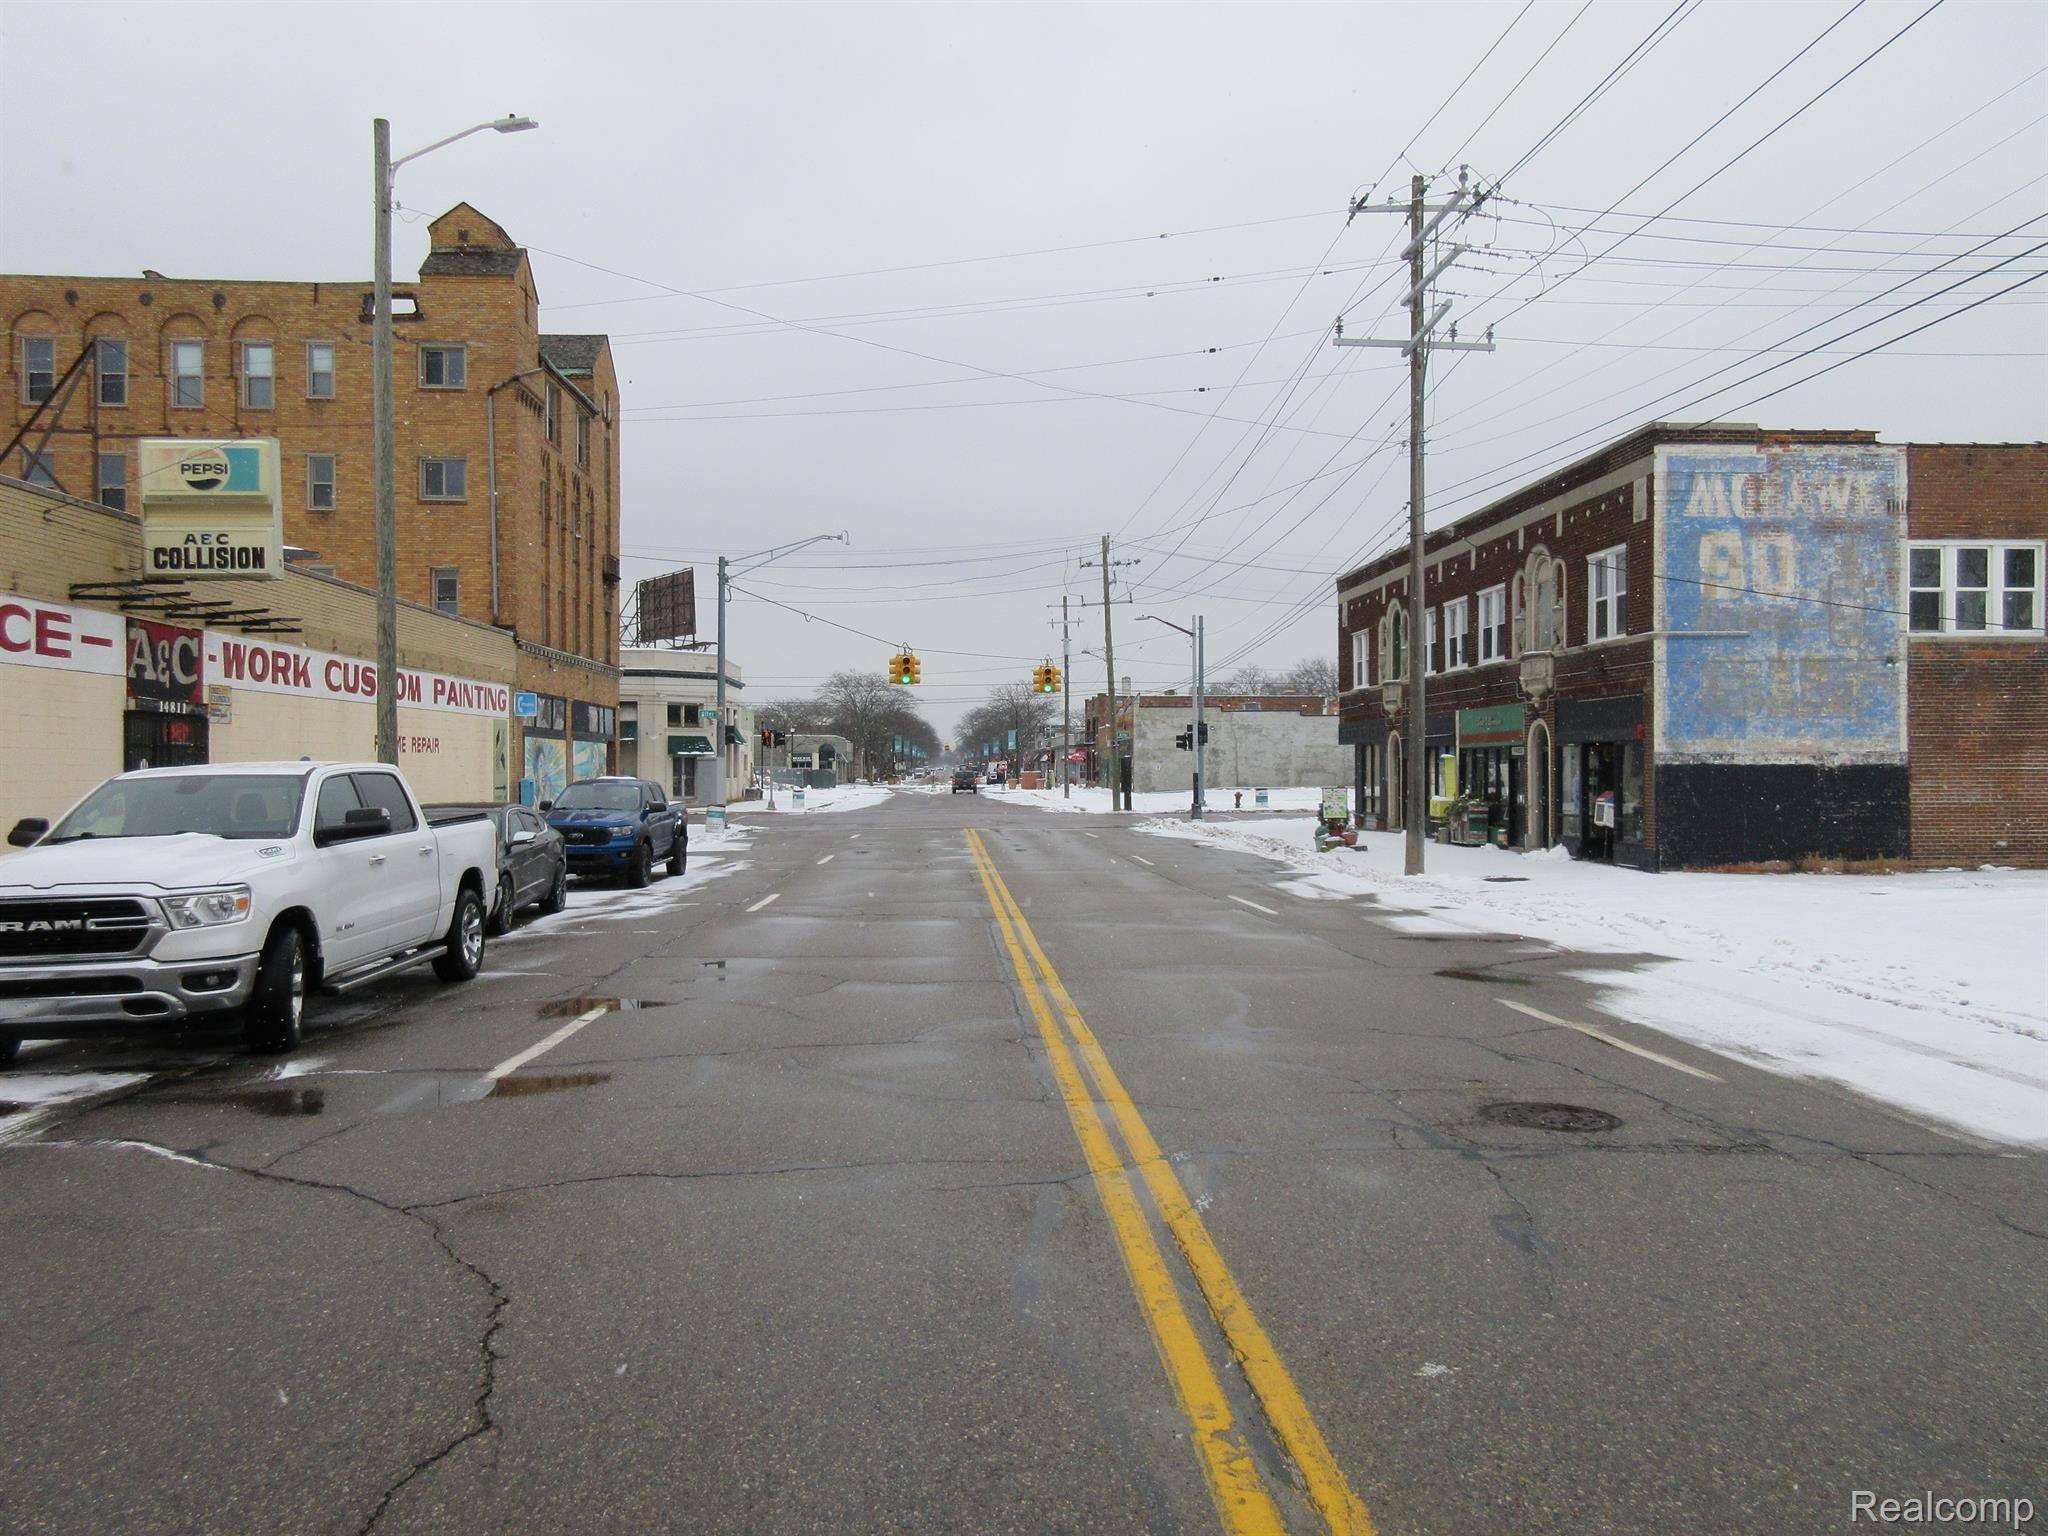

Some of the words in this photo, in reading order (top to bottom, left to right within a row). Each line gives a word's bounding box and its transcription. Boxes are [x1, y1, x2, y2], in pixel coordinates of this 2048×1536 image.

[181, 463, 228, 475] PEPSI
[153, 547, 266, 570] COLLISION
[1700, 531, 1796, 599] 90
[128, 626, 199, 689] A&C
[324, 659, 422, 703] CUSOM
[433, 678, 507, 712] PAINTING
[159, 701, 187, 714] 14811
[411, 736, 441, 754] REPAIR
[0, 919, 82, 932] RAM
